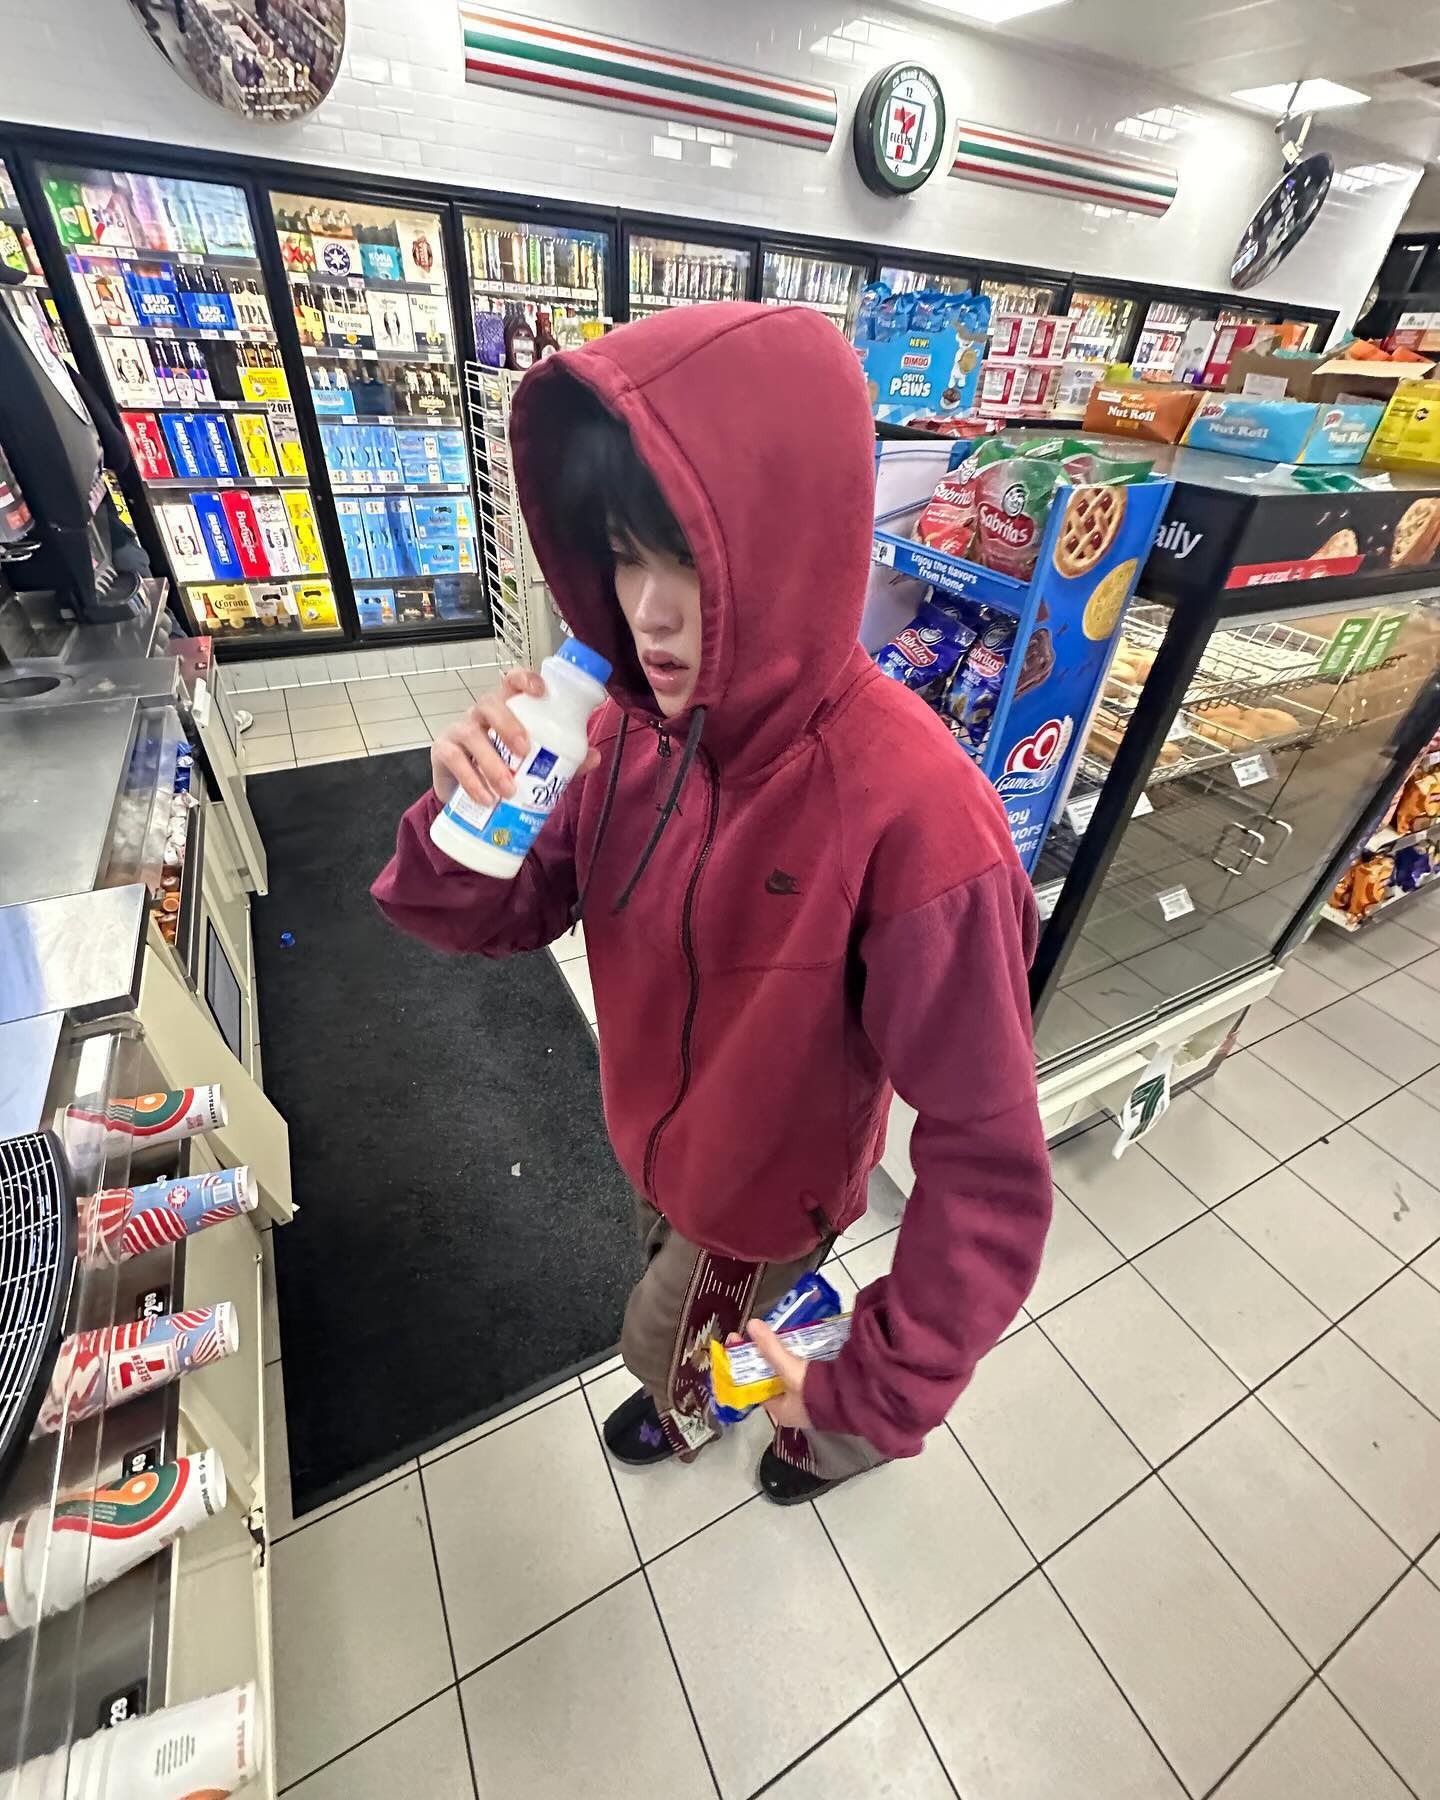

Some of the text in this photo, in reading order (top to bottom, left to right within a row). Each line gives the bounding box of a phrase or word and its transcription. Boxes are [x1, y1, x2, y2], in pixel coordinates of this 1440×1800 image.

[906, 87, 912, 98] 12
[143, 293, 169, 304] BUD
[141, 303, 176, 316] LIGHT
[197, 305, 221, 315] BUD
[197, 312, 226, 323] LIGHT
[237, 304, 270, 325] IPA
[903, 356, 929, 368] BIMBO
[889, 377, 932, 397] Paws
[277, 403, 292, 413] OFF
[1107, 405, 1156, 422] Nut Roll
[136, 421, 160, 476] Budweiser
[979, 504, 1029, 544] Sabritas
[236, 510, 258, 565] Budweiser
[1152, 521, 1203, 559] aily
[911, 552, 933, 569] Enjoy
[918, 566, 965, 591] from home
[896, 631, 929, 664] Sabritas
[969, 647, 1002, 671] abritas
[997, 776, 1047, 792] Gamesa
